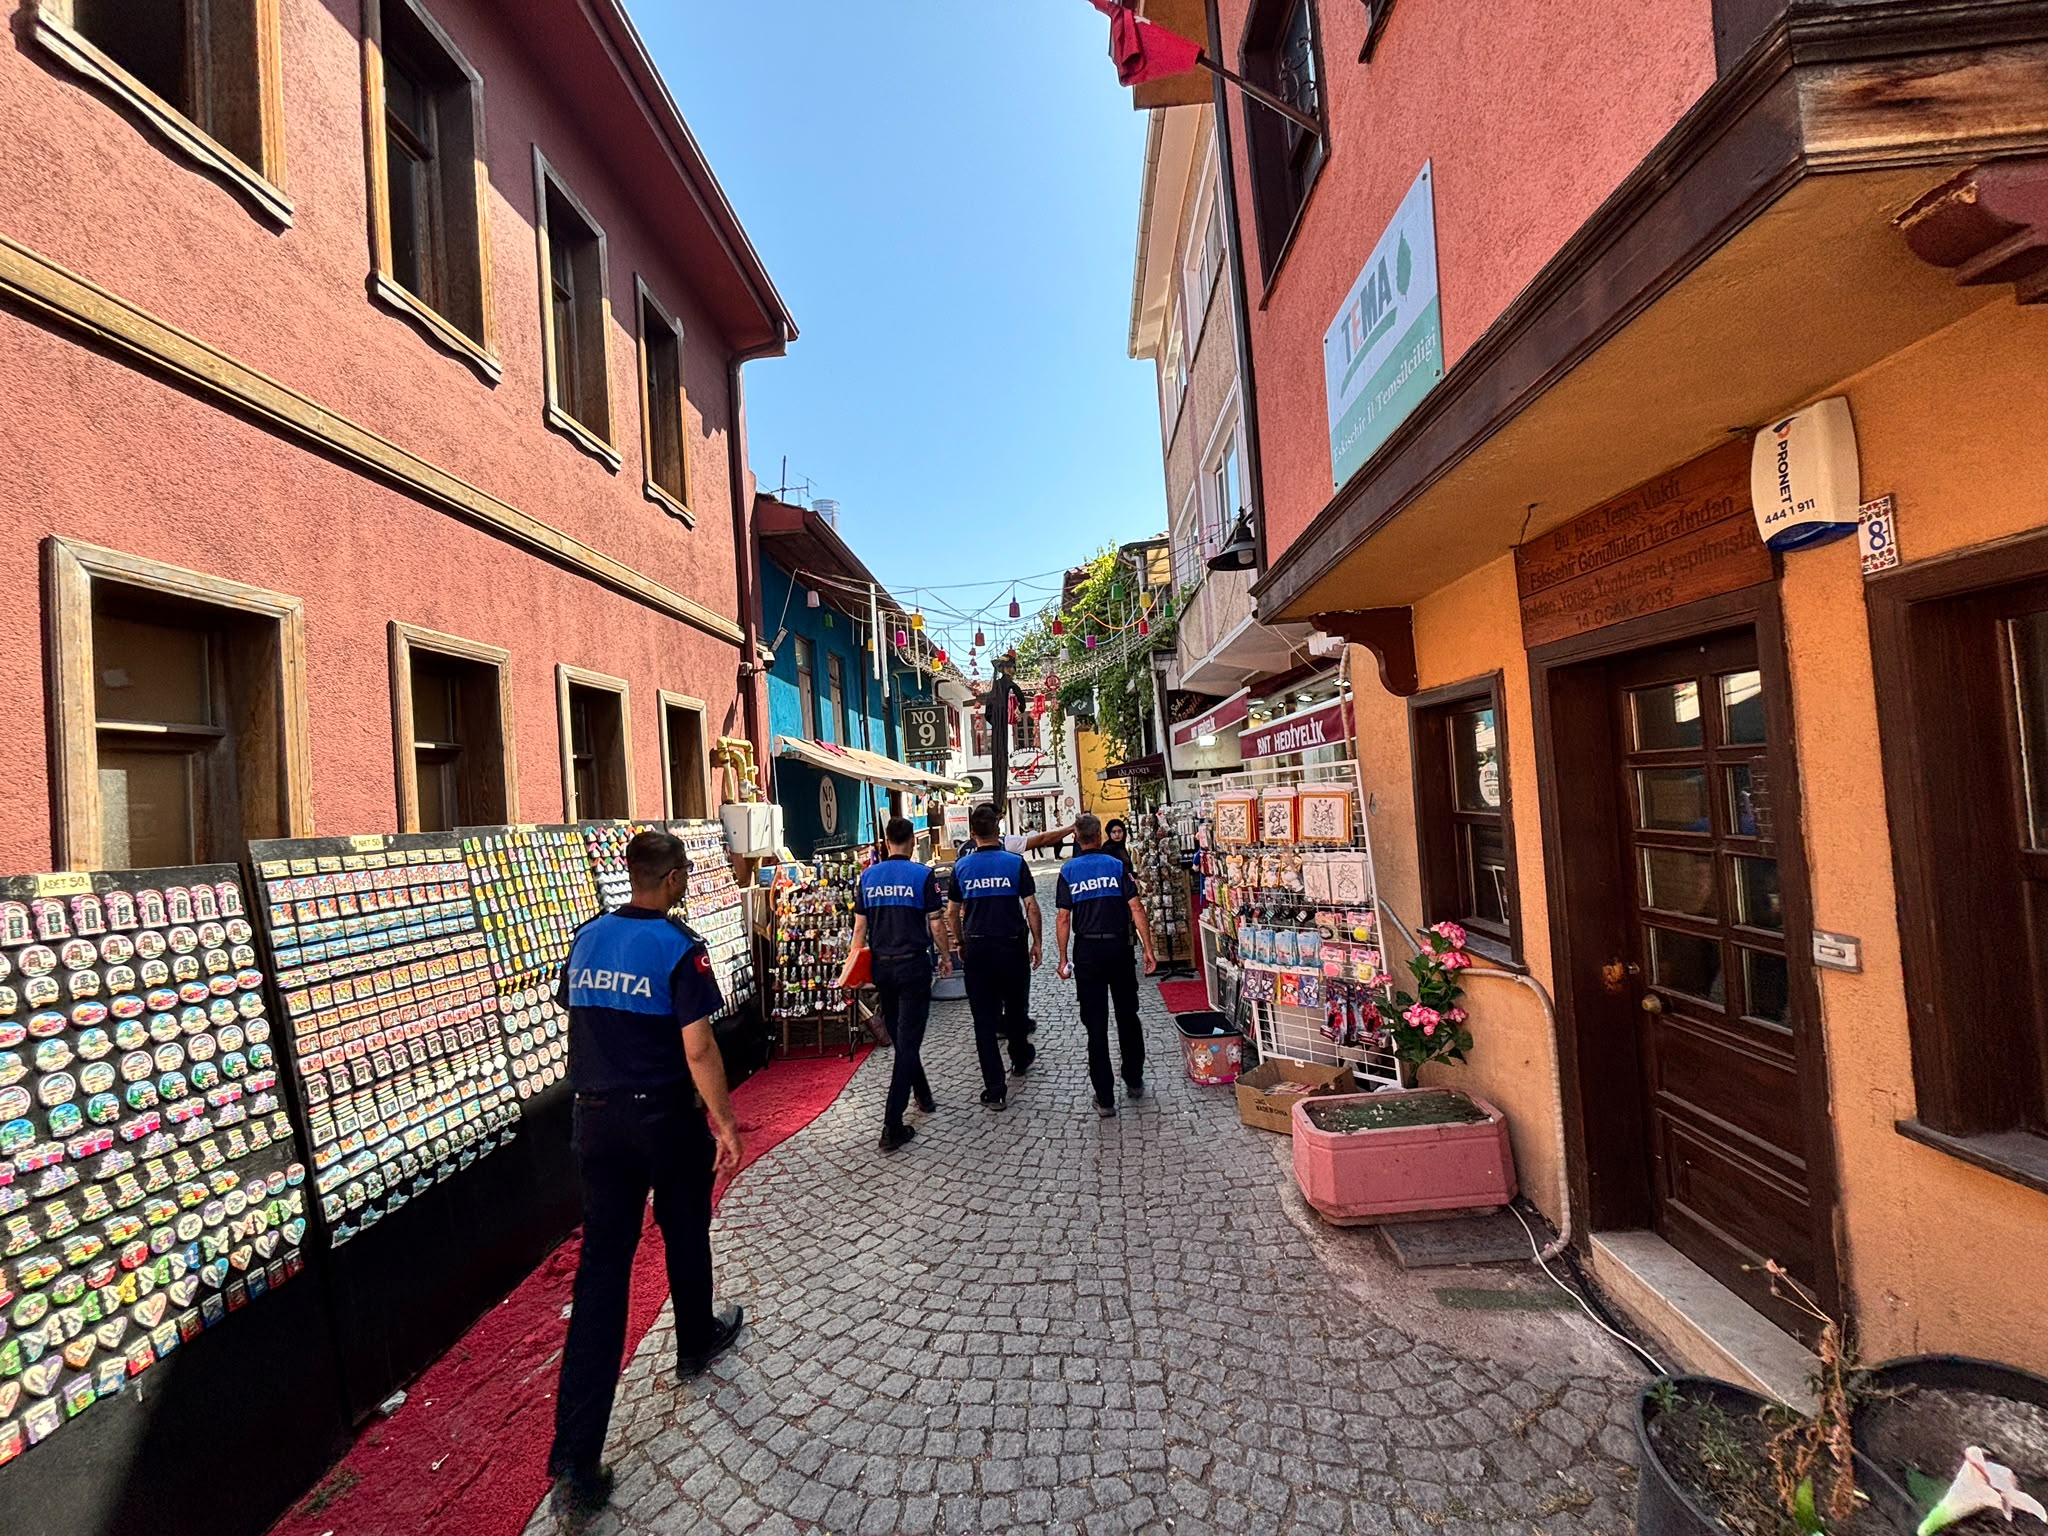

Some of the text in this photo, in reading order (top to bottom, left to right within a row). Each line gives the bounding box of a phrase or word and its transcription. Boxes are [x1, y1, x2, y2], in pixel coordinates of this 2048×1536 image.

[1341, 255, 1393, 364] TEMA
[1375, 326, 1437, 412] Temsilciliği
[1777, 440, 1793, 503] PRONET
[1765, 499, 1816, 524] 444 1 911
[1594, 600, 1632, 623] OCAK
[911, 710, 940, 724] NO.
[919, 724, 936, 746] 9
[1256, 717, 1326, 755] BNT HEDİYELİK
[826, 804, 832, 829] 9
[866, 885, 914, 898] ZABITA
[964, 877, 1011, 890] ZABITA
[1069, 876, 1119, 895] ZABITA
[569, 968, 652, 998] ZABITA
